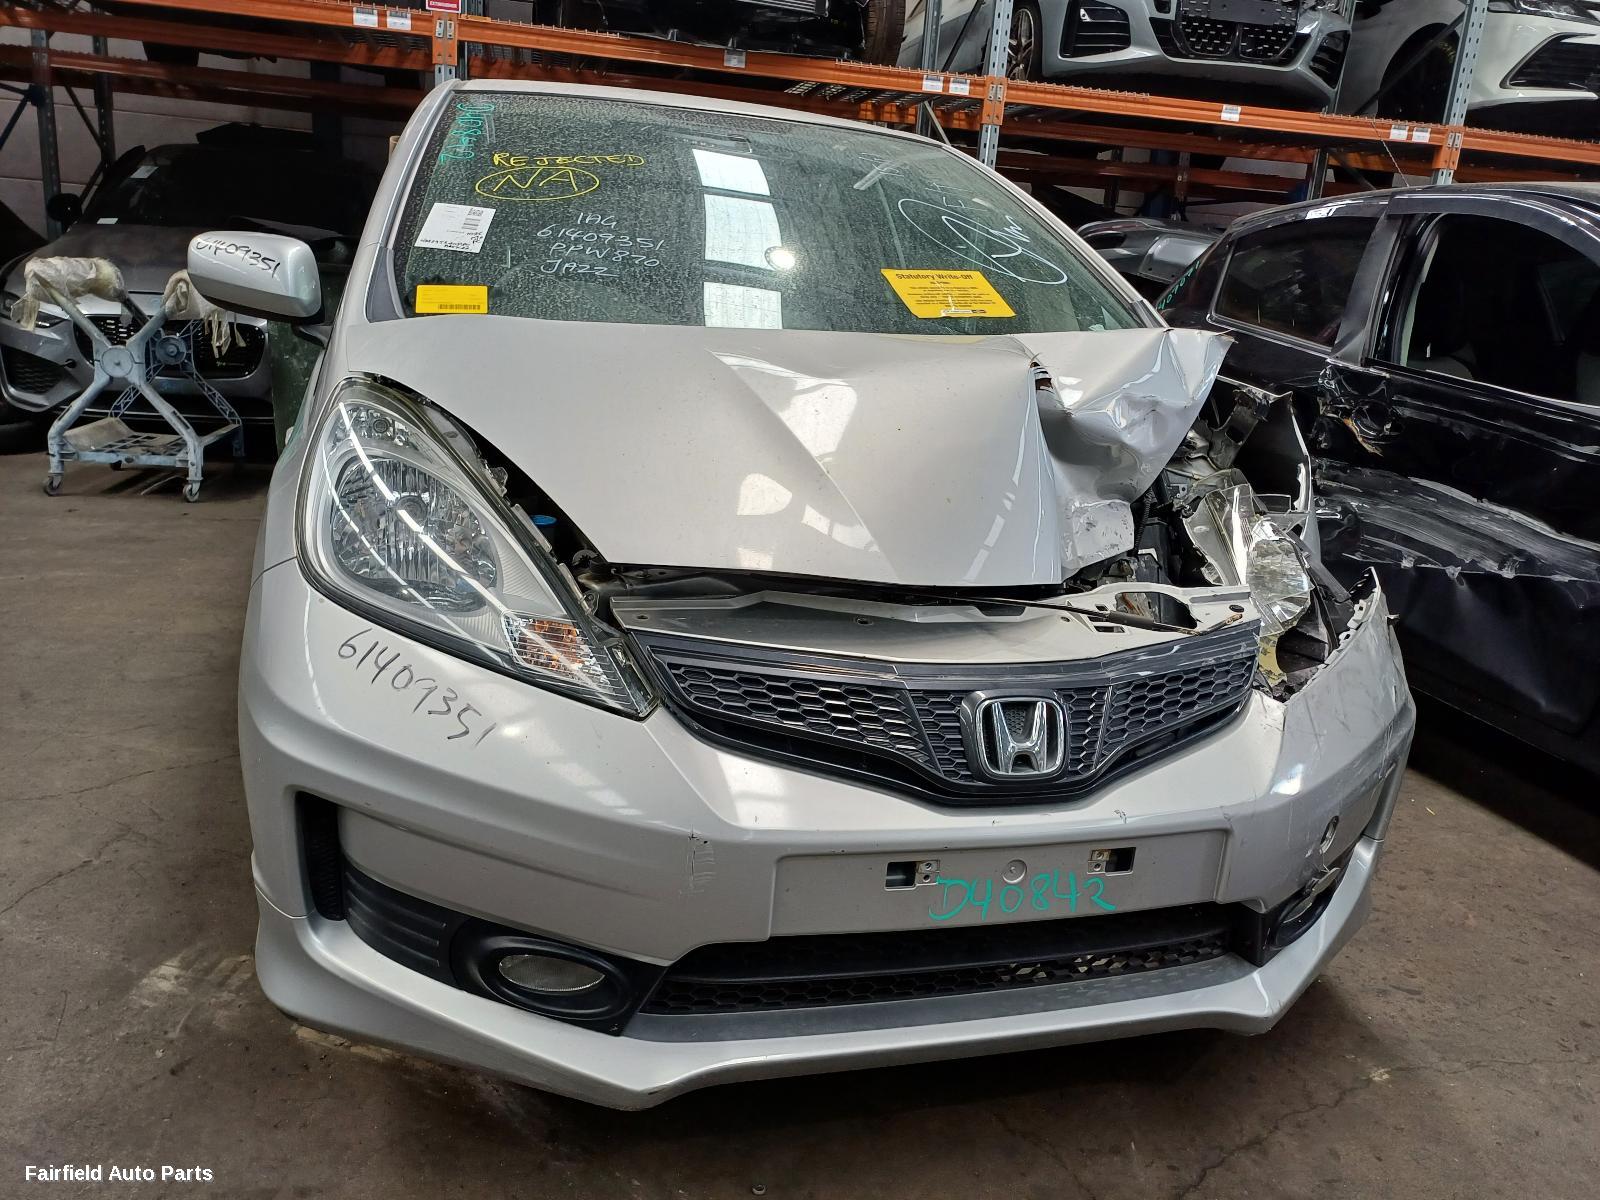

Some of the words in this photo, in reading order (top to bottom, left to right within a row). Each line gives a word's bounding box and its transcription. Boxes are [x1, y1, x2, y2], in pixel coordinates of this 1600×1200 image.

[492, 151, 645, 167] REJECTED
[536, 223, 665, 251] 61409351
[540, 258, 620, 277] JAZZ
[895, 273, 935, 281] Statutory
[338, 627, 497, 747] 61409351
[928, 868, 1117, 921] D40842
